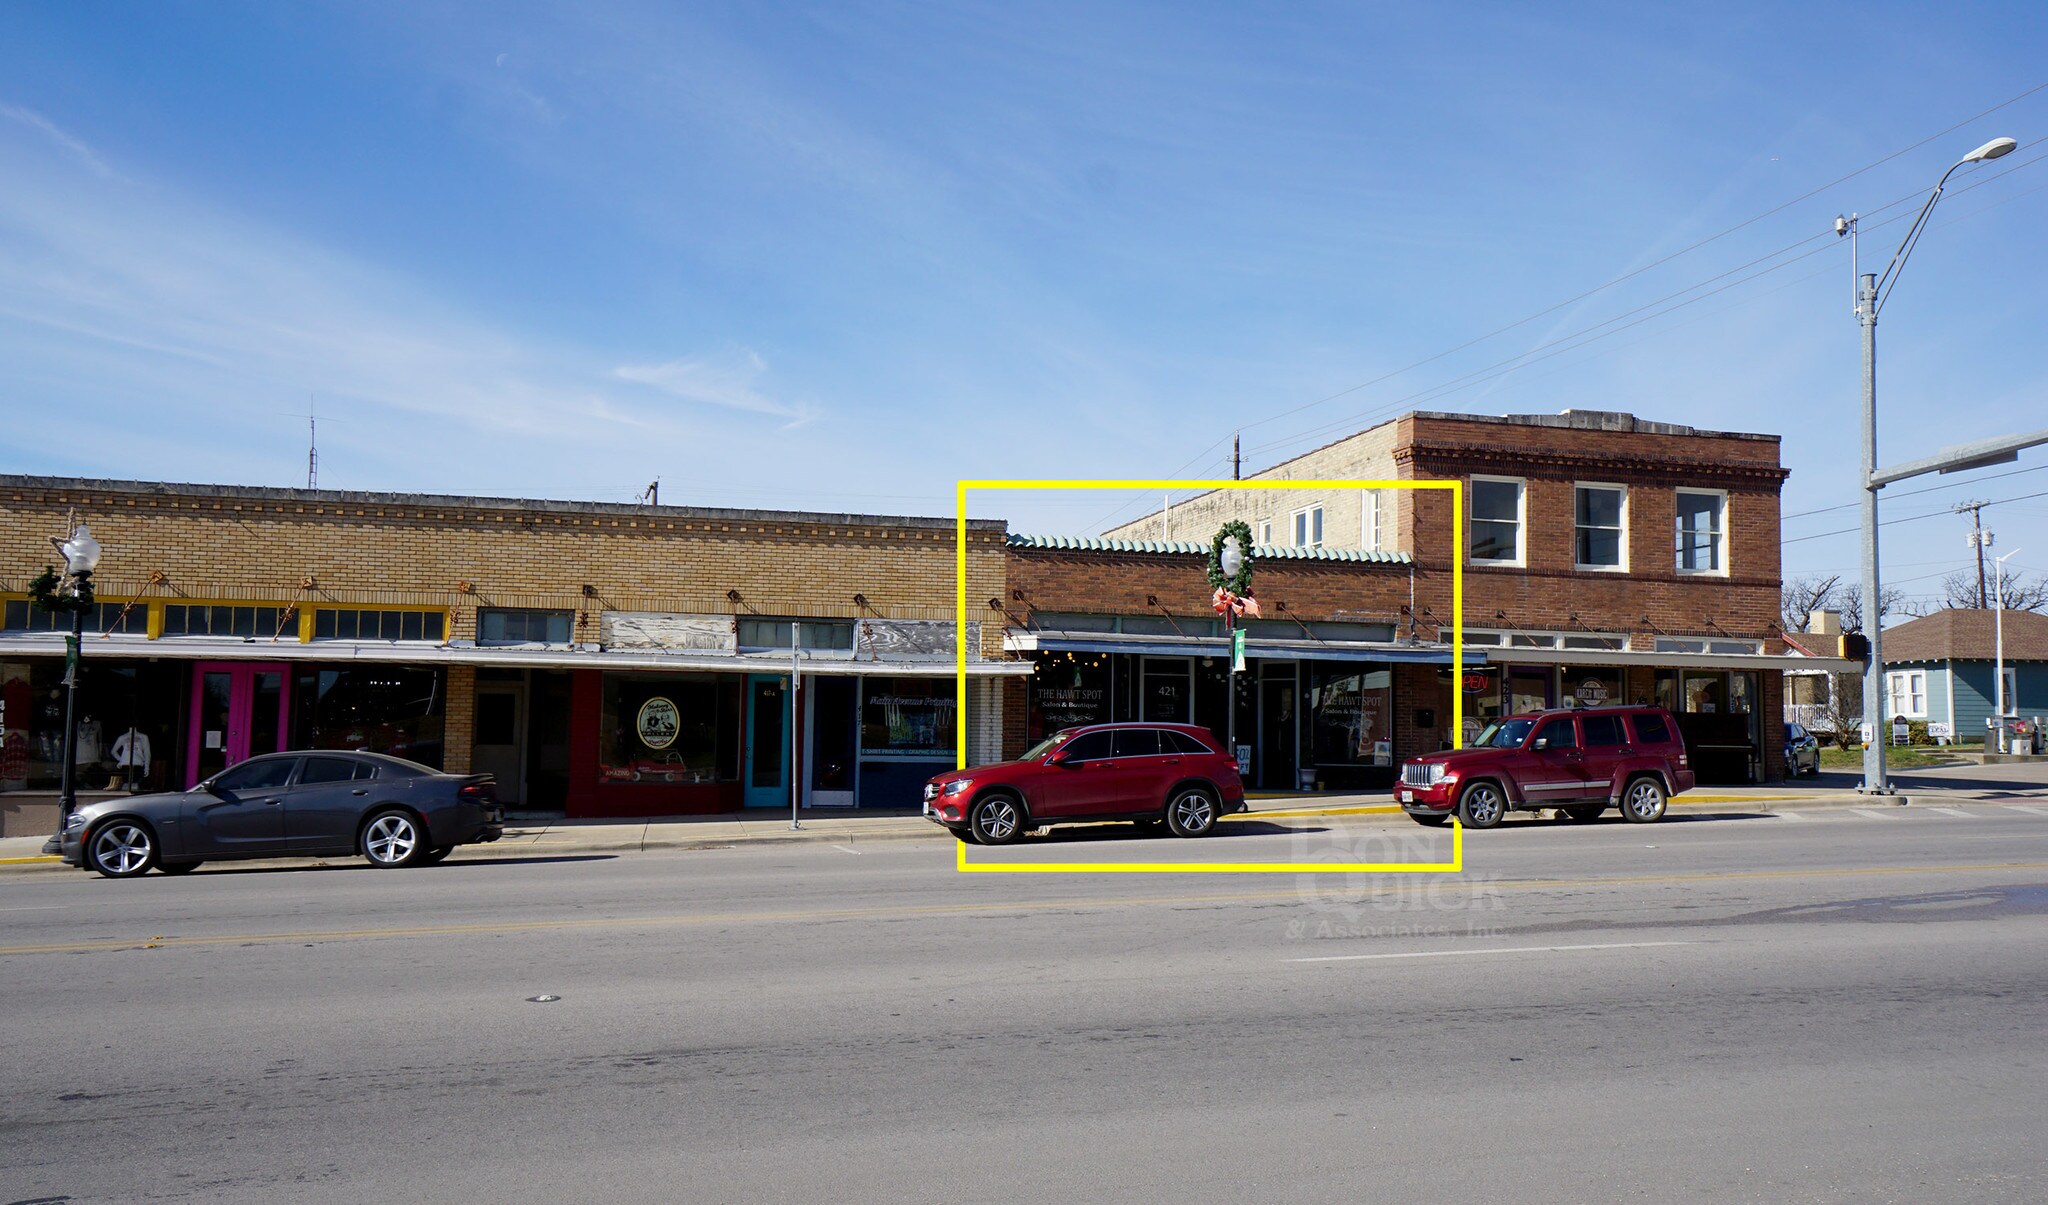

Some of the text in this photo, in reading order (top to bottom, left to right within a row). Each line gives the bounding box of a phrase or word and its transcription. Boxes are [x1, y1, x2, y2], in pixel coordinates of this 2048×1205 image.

[1463, 675, 1489, 689] PEN
[1037, 688, 1103, 700] THE HAWT SPOT
[1158, 686, 1175, 696] 421
[1068, 702, 1098, 710] Boutique
[1338, 696, 1361, 706] HAWT
[1363, 696, 1382, 707] SPOT
